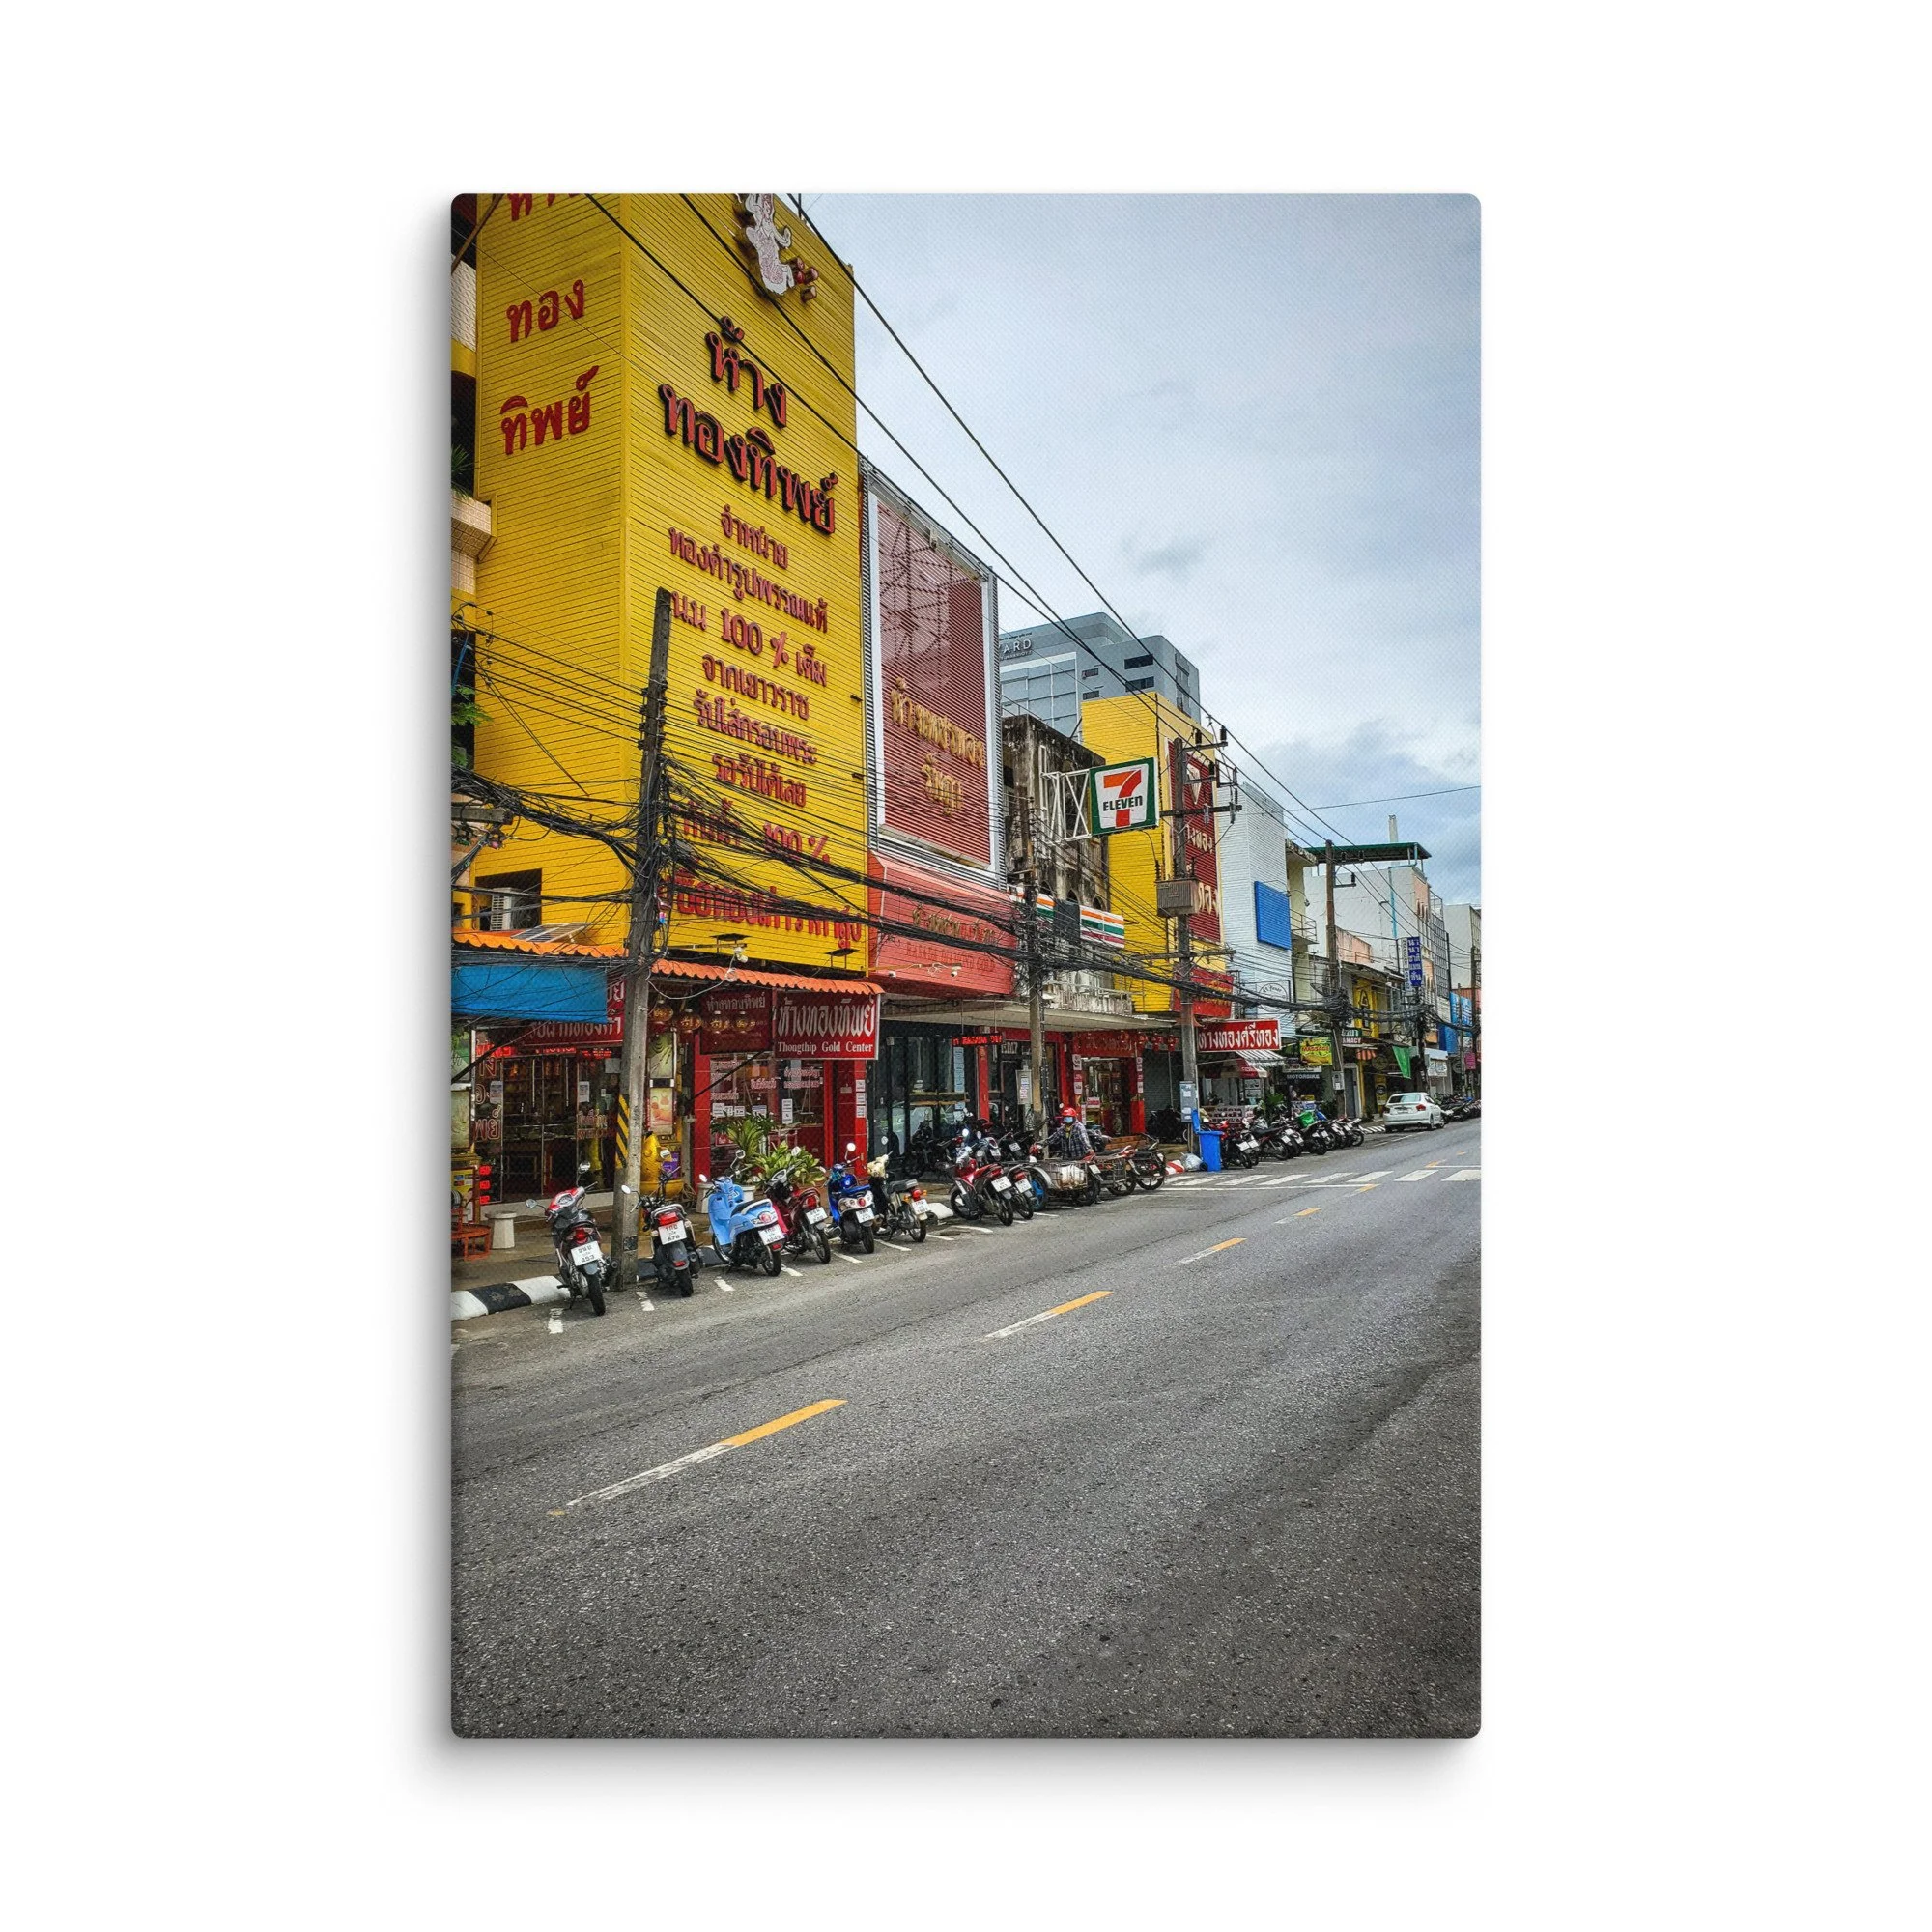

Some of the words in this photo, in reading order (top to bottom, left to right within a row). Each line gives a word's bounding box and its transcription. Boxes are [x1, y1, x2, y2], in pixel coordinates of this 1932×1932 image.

[506, 279, 585, 344] ทอง
[705, 315, 788, 430] ห้าง
[499, 365, 600, 457] ทิพย์
[659, 383, 839, 536] ทองทิพย์
[721, 504, 789, 570] จำหน่าย
[720, 607, 763, 656] 100
[999, 639, 1032, 654] ARD
[1103, 770, 1142, 828] 7
[778, 994, 875, 1037] ห้างทองทิพย์
[778, 1041, 817, 1055] Thongthip
[821, 1041, 841, 1052] Gold
[845, 1041, 874, 1052] Center
